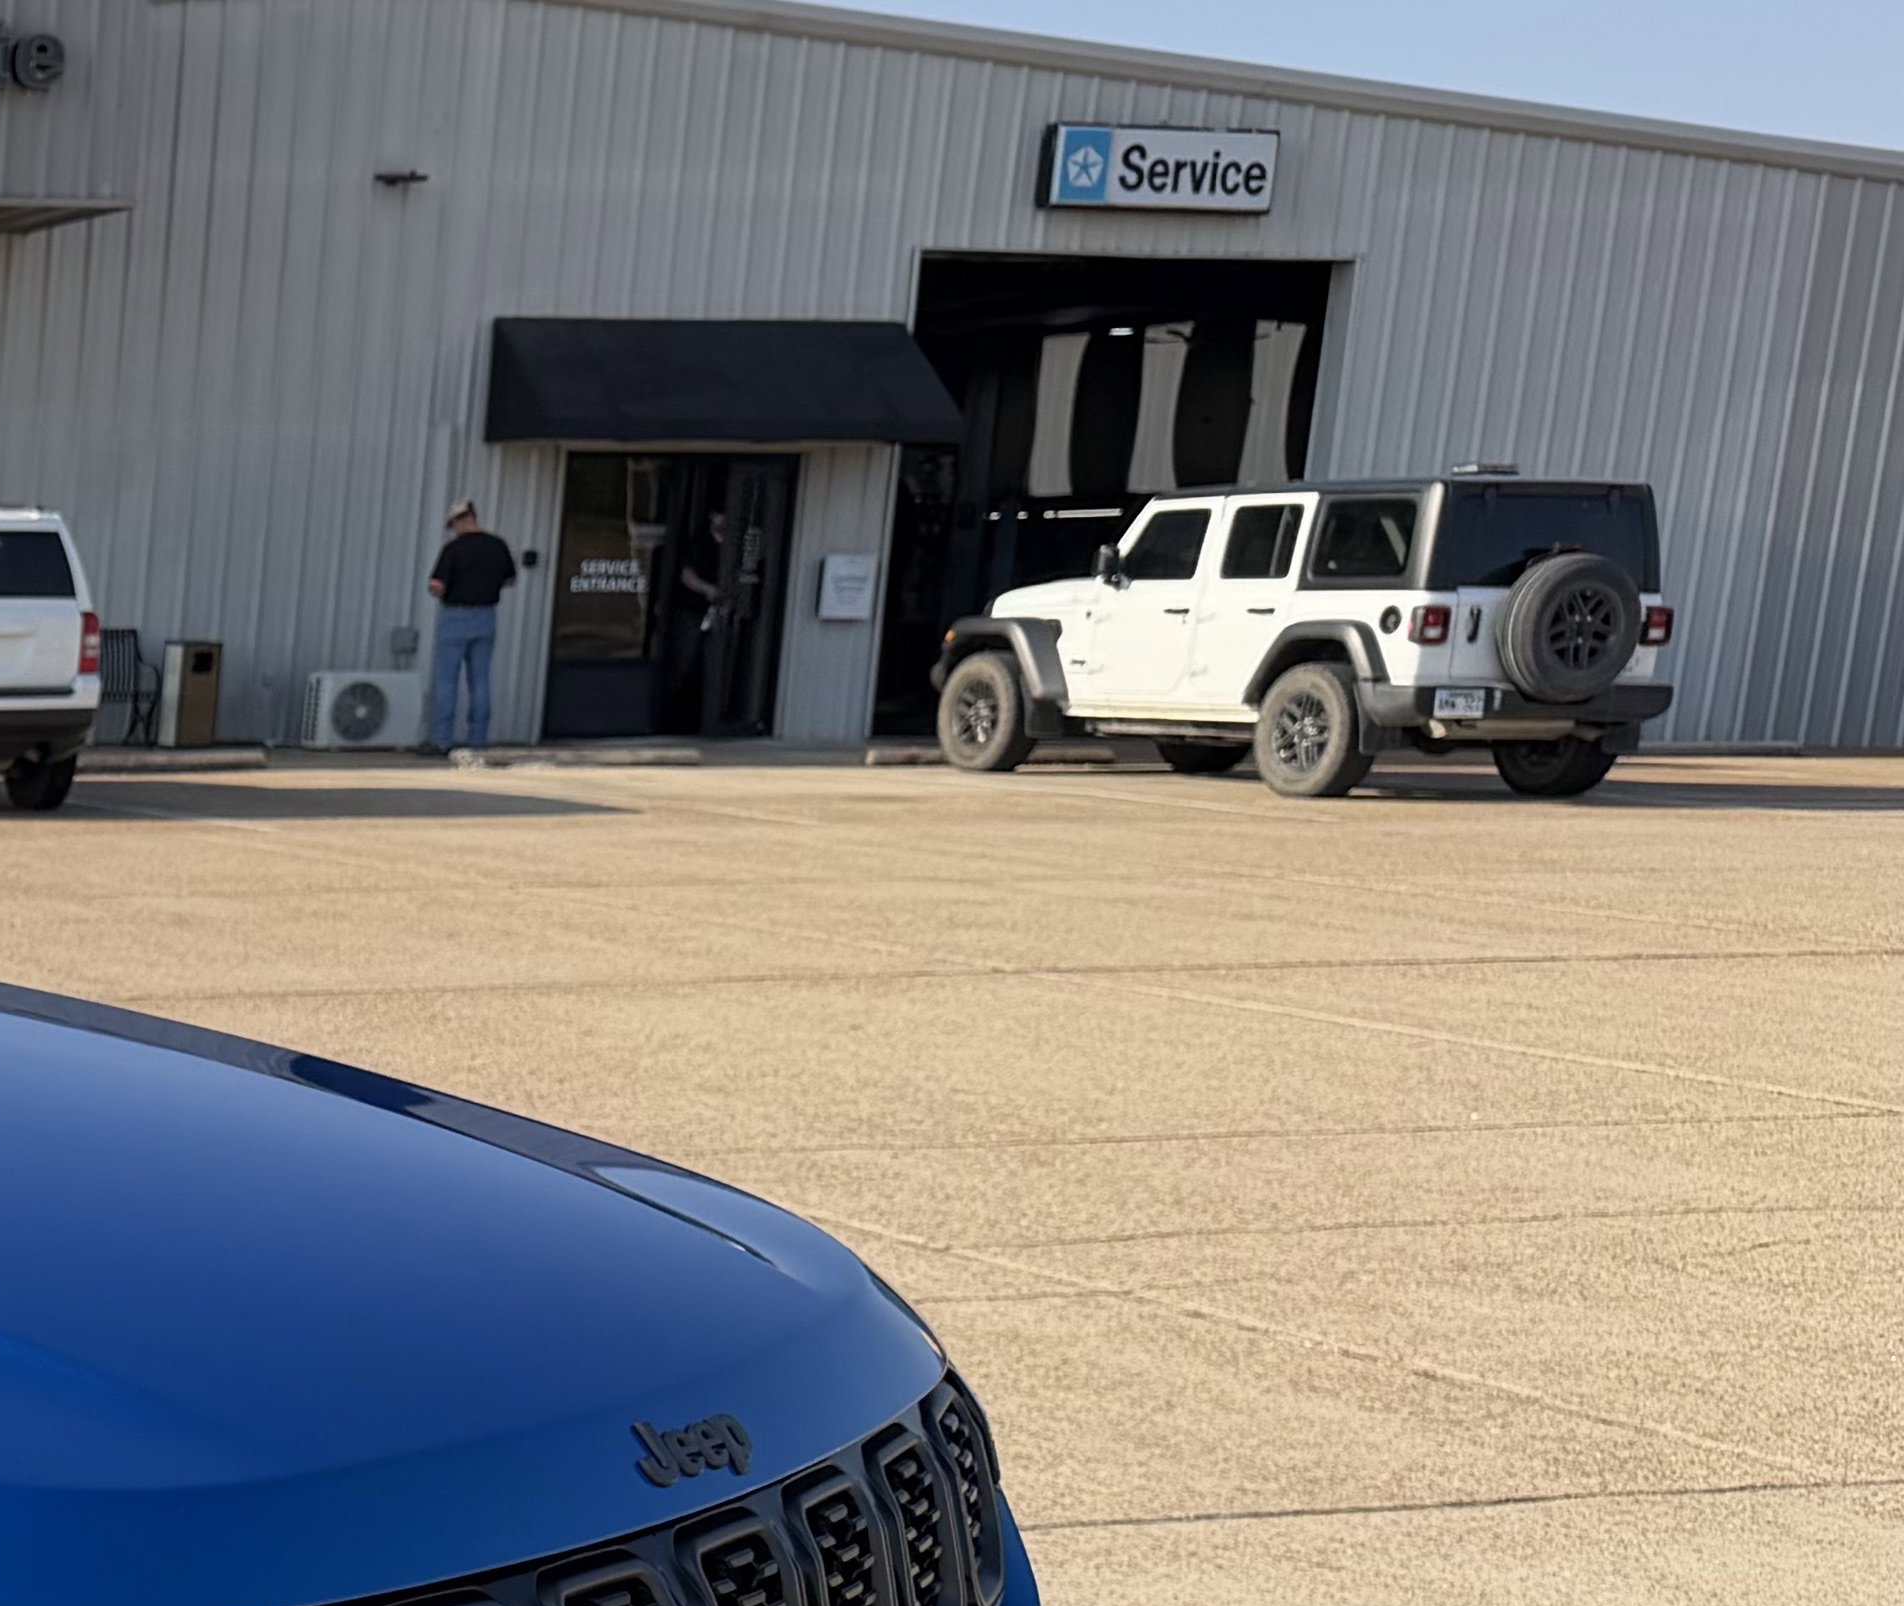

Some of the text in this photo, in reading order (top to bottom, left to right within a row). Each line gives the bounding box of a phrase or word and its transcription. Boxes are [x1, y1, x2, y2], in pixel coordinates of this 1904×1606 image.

[1118, 144, 1267, 196] Service
[570, 575, 647, 593] ENTRANCE
[580, 558, 639, 575] SERVICE
[630, 1413, 752, 1488] Jeep
